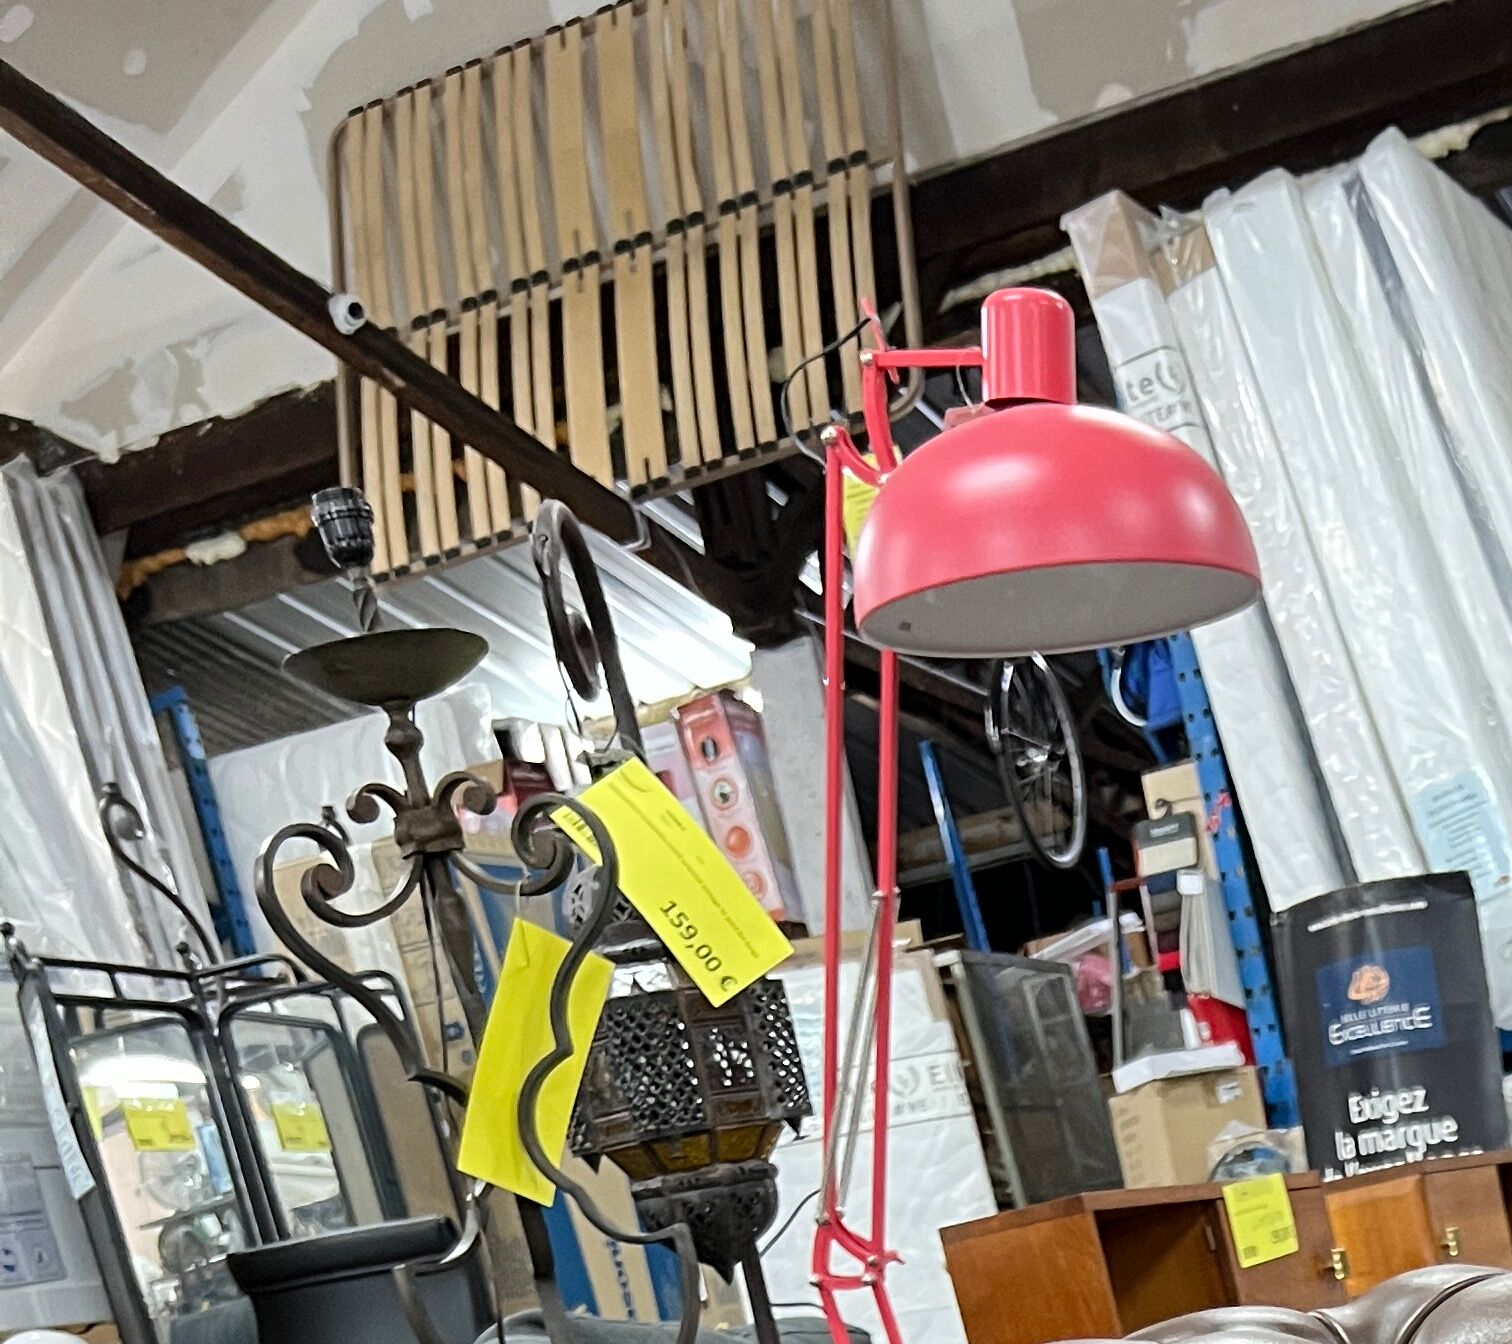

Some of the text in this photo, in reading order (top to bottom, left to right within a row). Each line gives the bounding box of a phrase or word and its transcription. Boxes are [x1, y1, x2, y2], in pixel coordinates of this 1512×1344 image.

[659, 899, 723, 973] 159,00
[719, 974, 738, 993] €
[1348, 1086, 1430, 1125] Exigez
[1335, 1115, 1460, 1161] la marque
